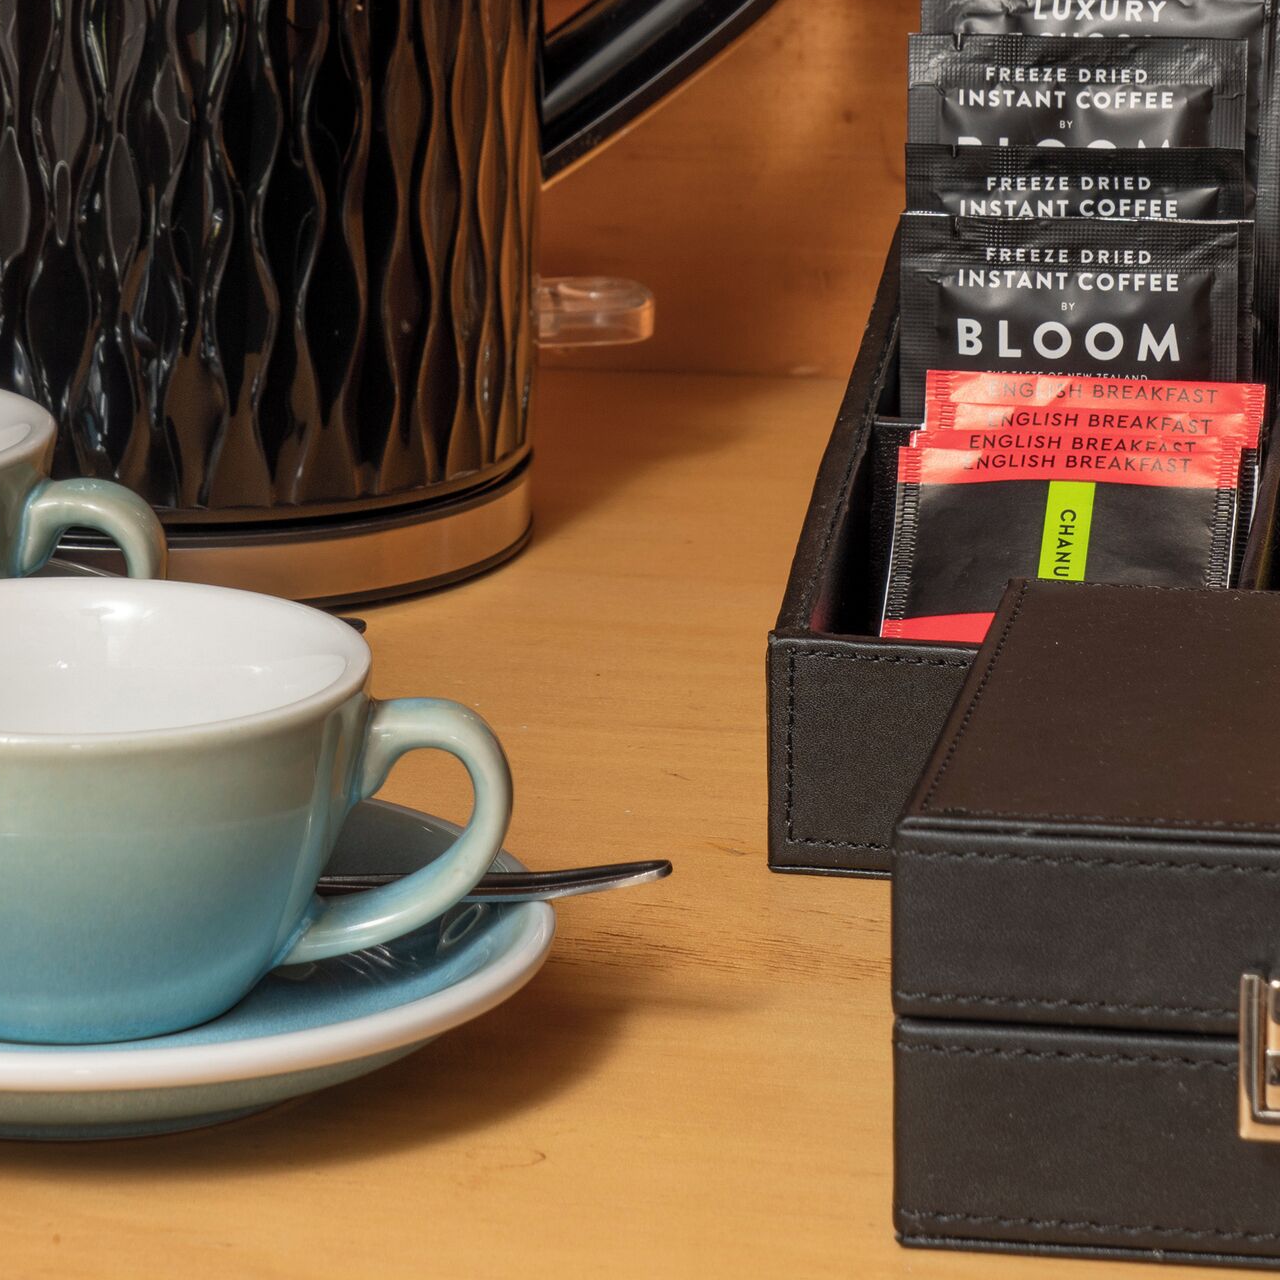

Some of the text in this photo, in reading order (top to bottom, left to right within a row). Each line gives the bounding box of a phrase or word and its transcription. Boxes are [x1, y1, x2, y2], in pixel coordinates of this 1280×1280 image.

[985, 67, 1148, 83] FREEZE DRIED
[958, 89, 1174, 109] INSTANT COFFEE
[1059, 120, 1073, 129] BY
[986, 176, 1151, 191] FREEZE DRIED
[959, 199, 1178, 218] INSTANT COFFEE
[985, 248, 1152, 264] FREEZE DRIED
[958, 269, 1179, 292] INSTANT COFFEE
[1061, 302, 1075, 311] BY
[957, 318, 1180, 362] BLOOM
[990, 382, 1218, 404] ENGLISH BREAKFAST
[988, 412, 1213, 435] ENGLISH BREAKFAST
[970, 434, 1196, 452] ENGLISH BREAKFAST
[964, 454, 1192, 473] ENGLISH BREAKFAST
[1053, 509, 1077, 577] CHANU
